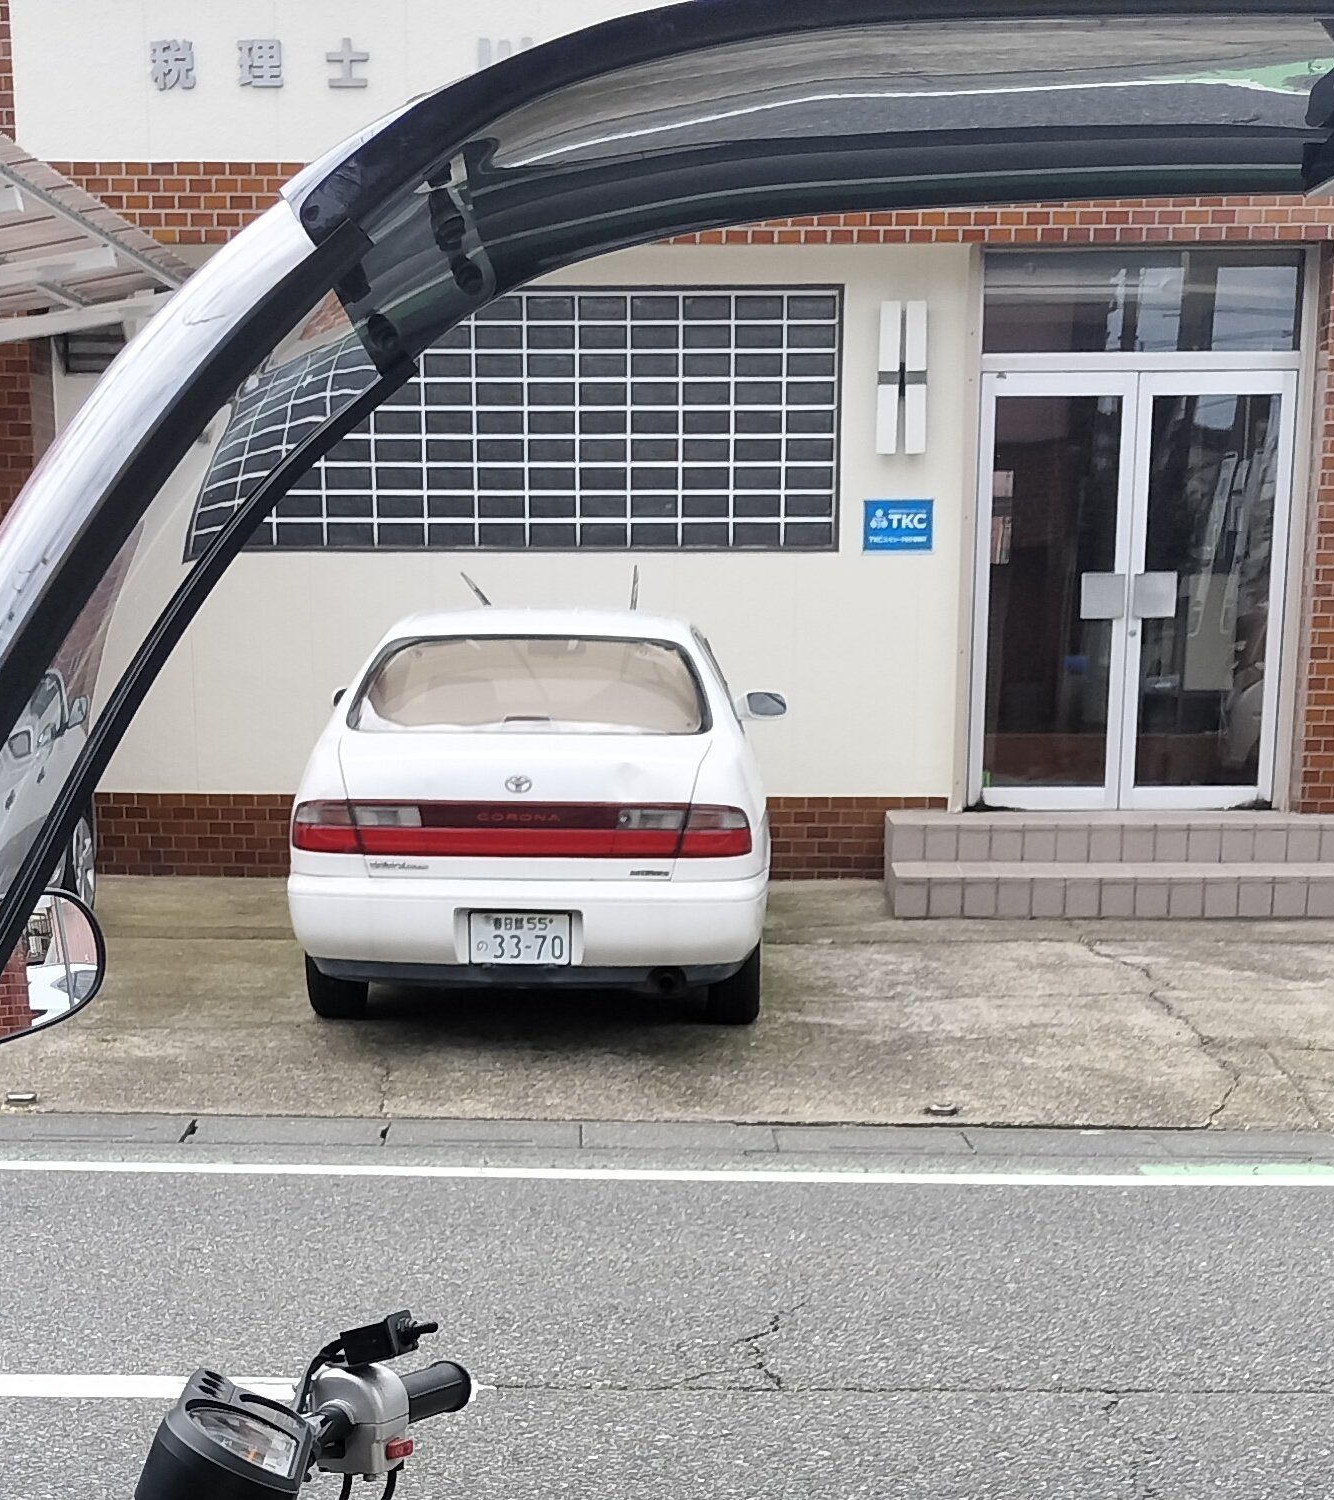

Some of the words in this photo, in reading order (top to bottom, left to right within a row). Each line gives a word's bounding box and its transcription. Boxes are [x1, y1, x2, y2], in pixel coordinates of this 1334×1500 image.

[149, 37, 371, 91] 税理士
[887, 513, 927, 529] TKC
[476, 813, 561, 822] CORONA
[476, 940, 489, 952] の
[492, 934, 564, 960] 33-70
